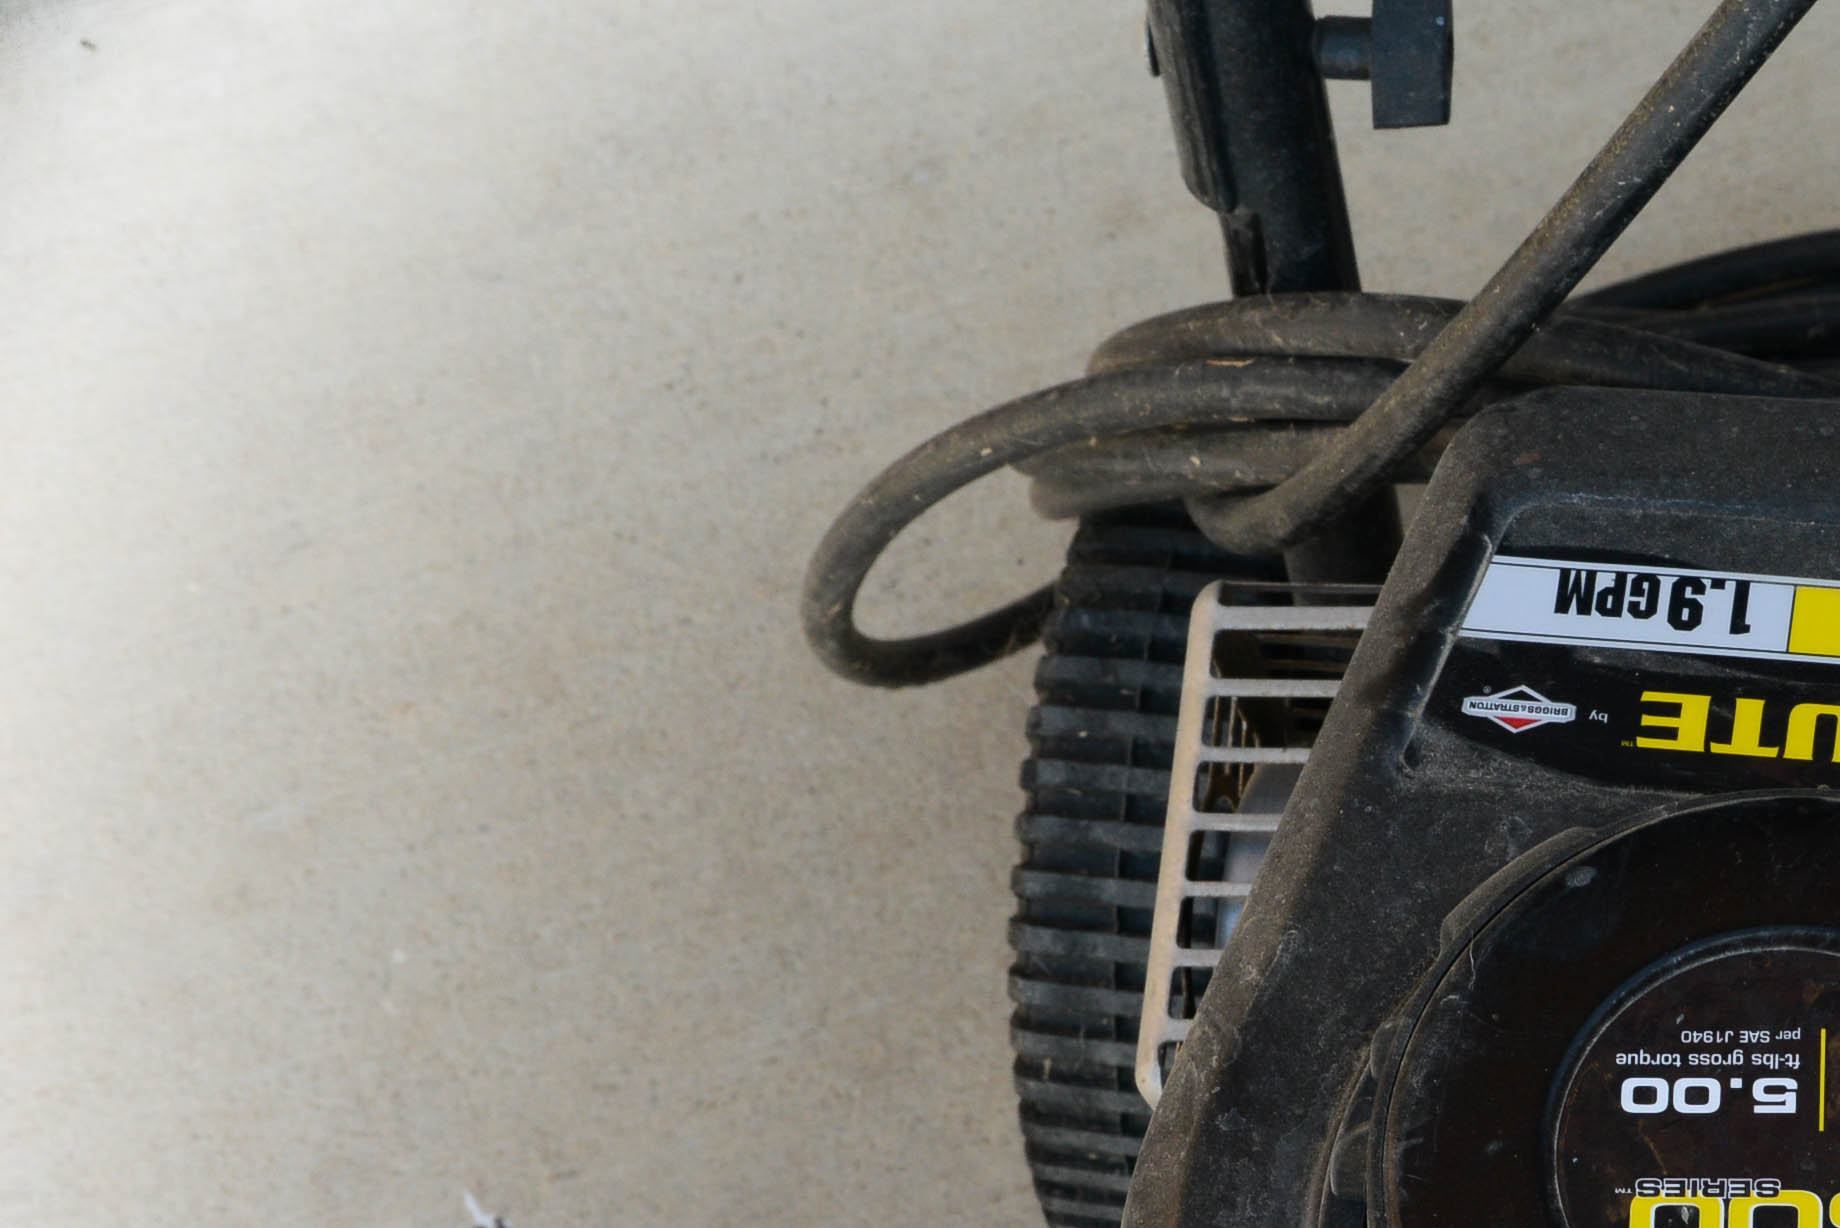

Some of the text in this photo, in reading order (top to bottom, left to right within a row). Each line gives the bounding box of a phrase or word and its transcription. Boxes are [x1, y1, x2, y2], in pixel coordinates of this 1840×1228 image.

[1554, 568, 1751, 635] 1.9 GPM
[1589, 710, 1608, 723] by
[1681, 1028, 1801, 1043] per SAE J1940
[1616, 1049, 1800, 1069] ft-lbs gross torque
[1620, 1077, 1798, 1114] 5.00
[1635, 1178, 1781, 1199] SERIES
